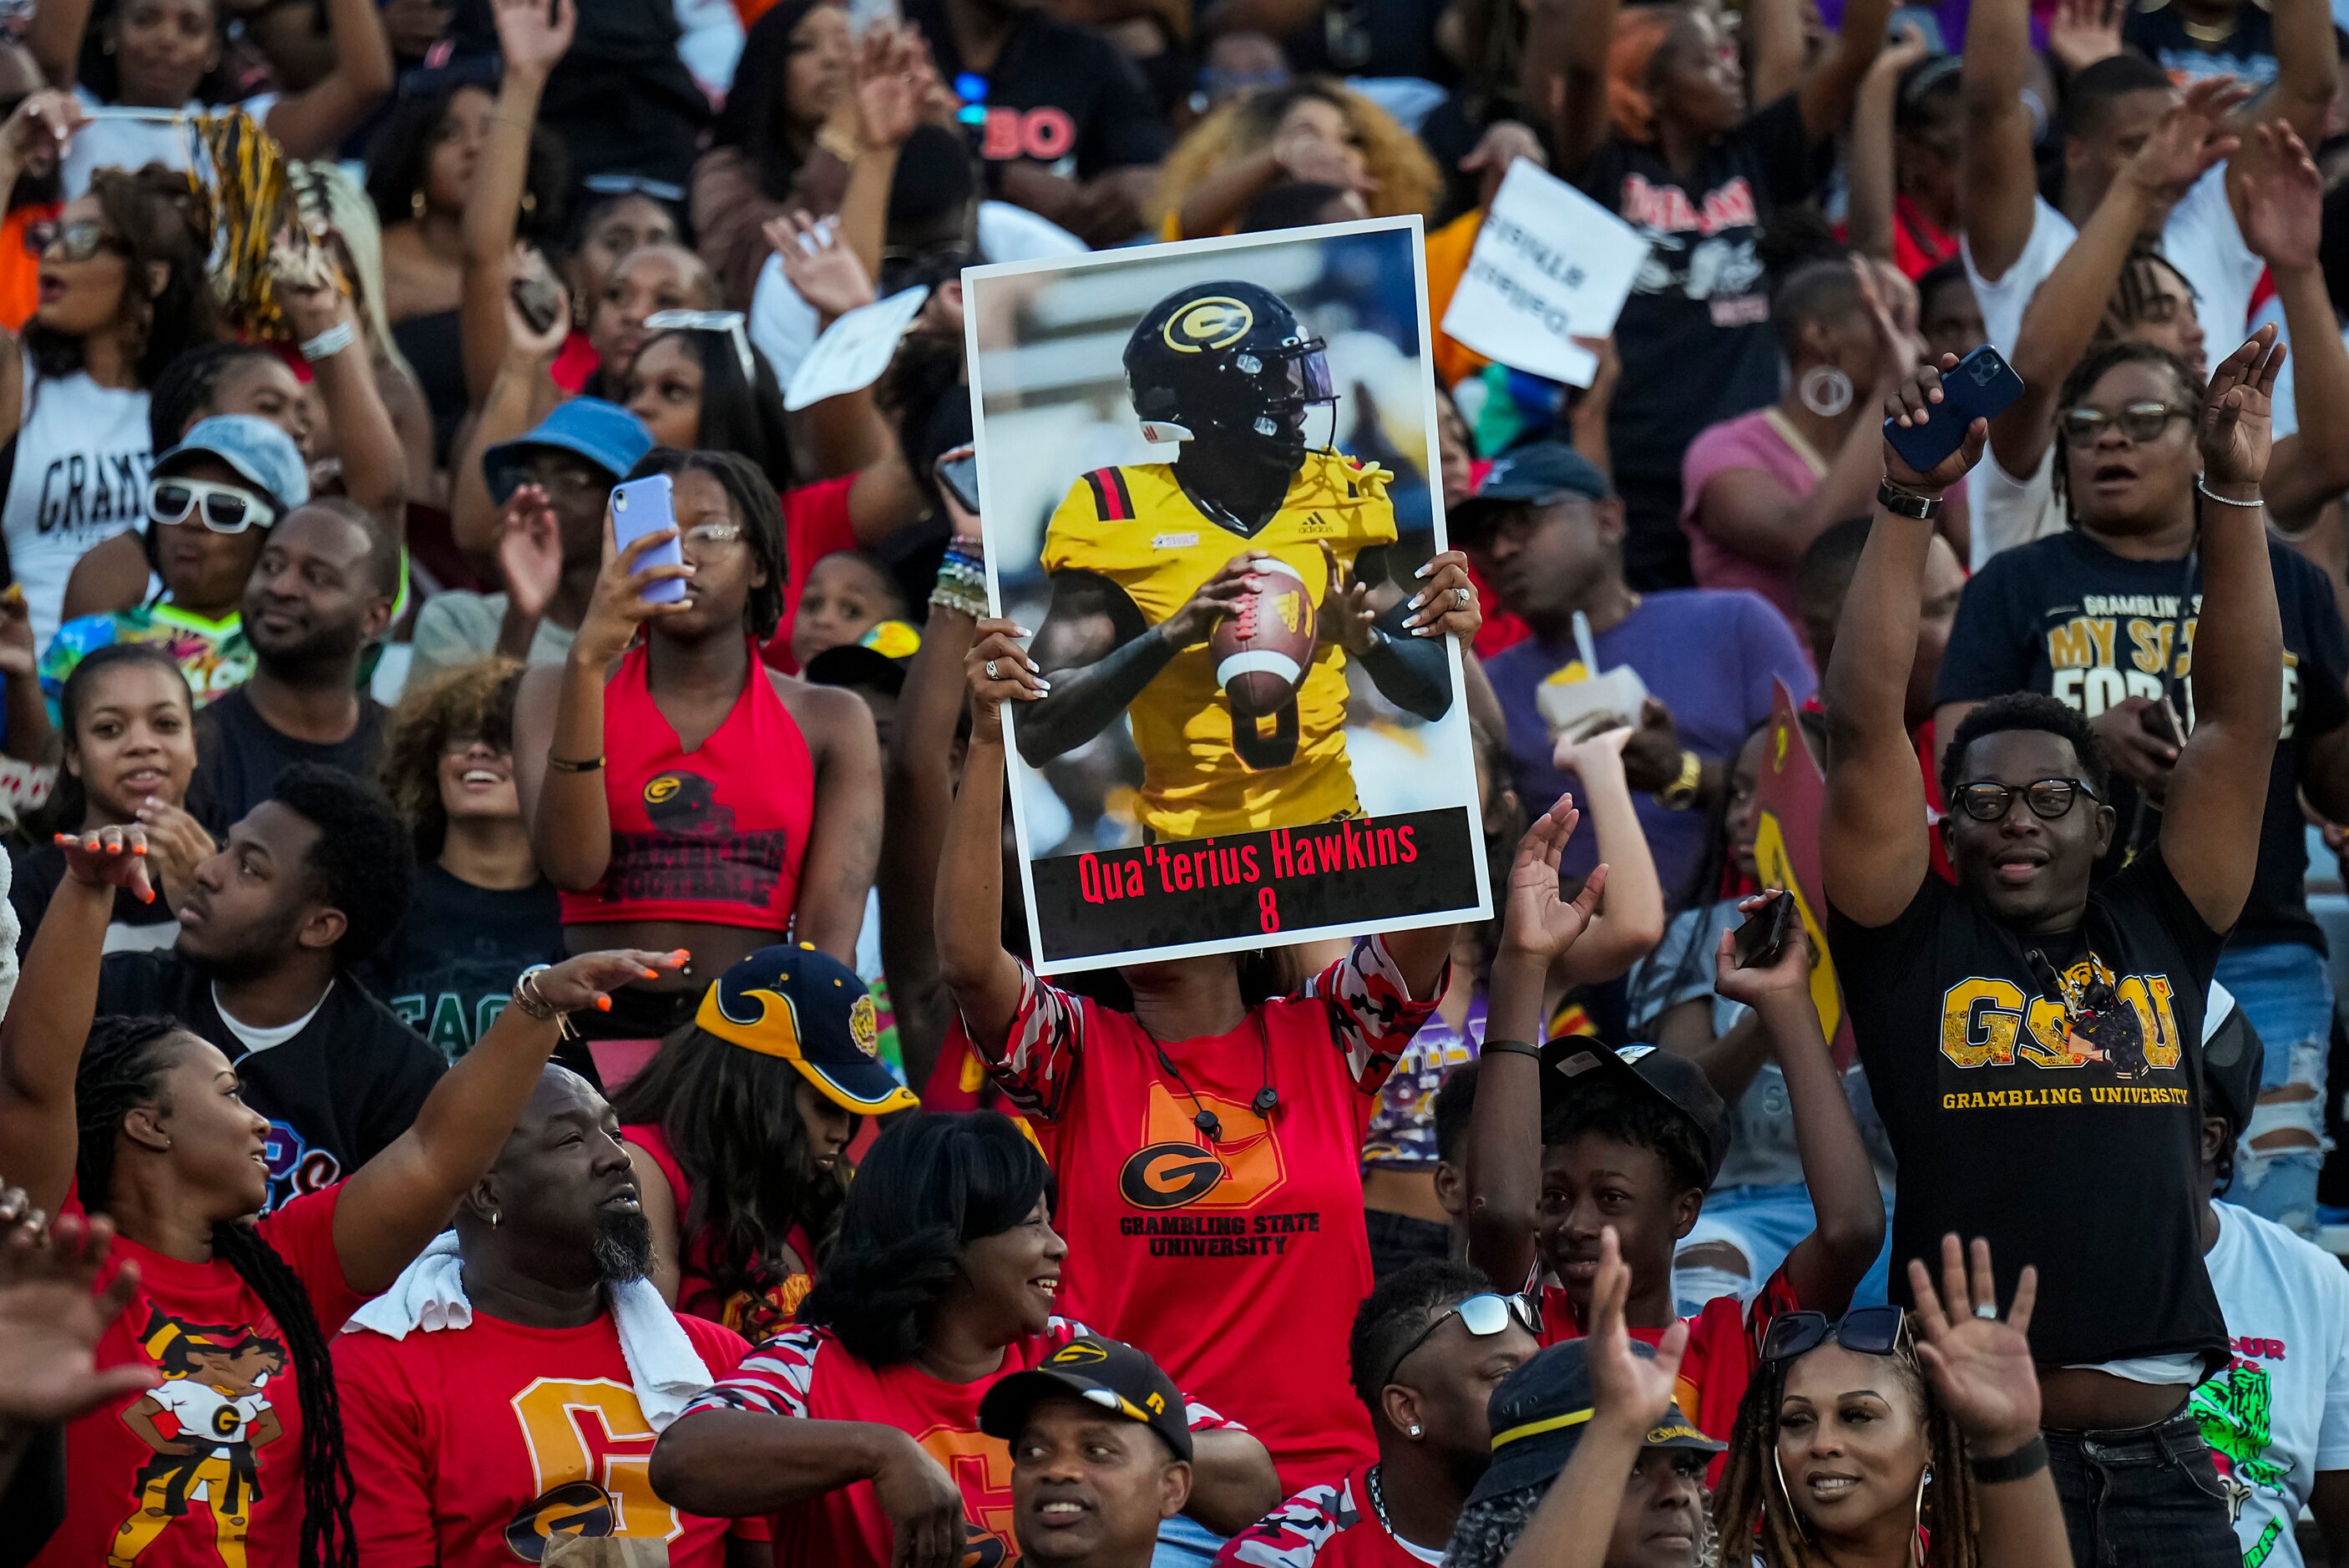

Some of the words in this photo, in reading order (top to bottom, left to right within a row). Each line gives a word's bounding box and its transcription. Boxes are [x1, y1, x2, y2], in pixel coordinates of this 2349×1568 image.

[37, 453, 151, 534] GRAM
[1298, 525, 1334, 534] adidas
[2083, 594, 2188, 619] GRAMBLIN
[2047, 615, 2117, 670] MY
[1078, 837, 1260, 904] Qua'terius
[1269, 818, 1417, 879] Hawkins
[1258, 887, 1280, 933] 8
[1940, 974, 2182, 1070] GSU
[1942, 1087, 2082, 1110] GRAMBLING
[2090, 1086, 2187, 1105] UNIVERSITY
[1120, 1216, 1245, 1236] GRAMBLING
[1253, 1212, 1319, 1232] STATE
[1149, 1236, 1288, 1257] UNIVERSITY
